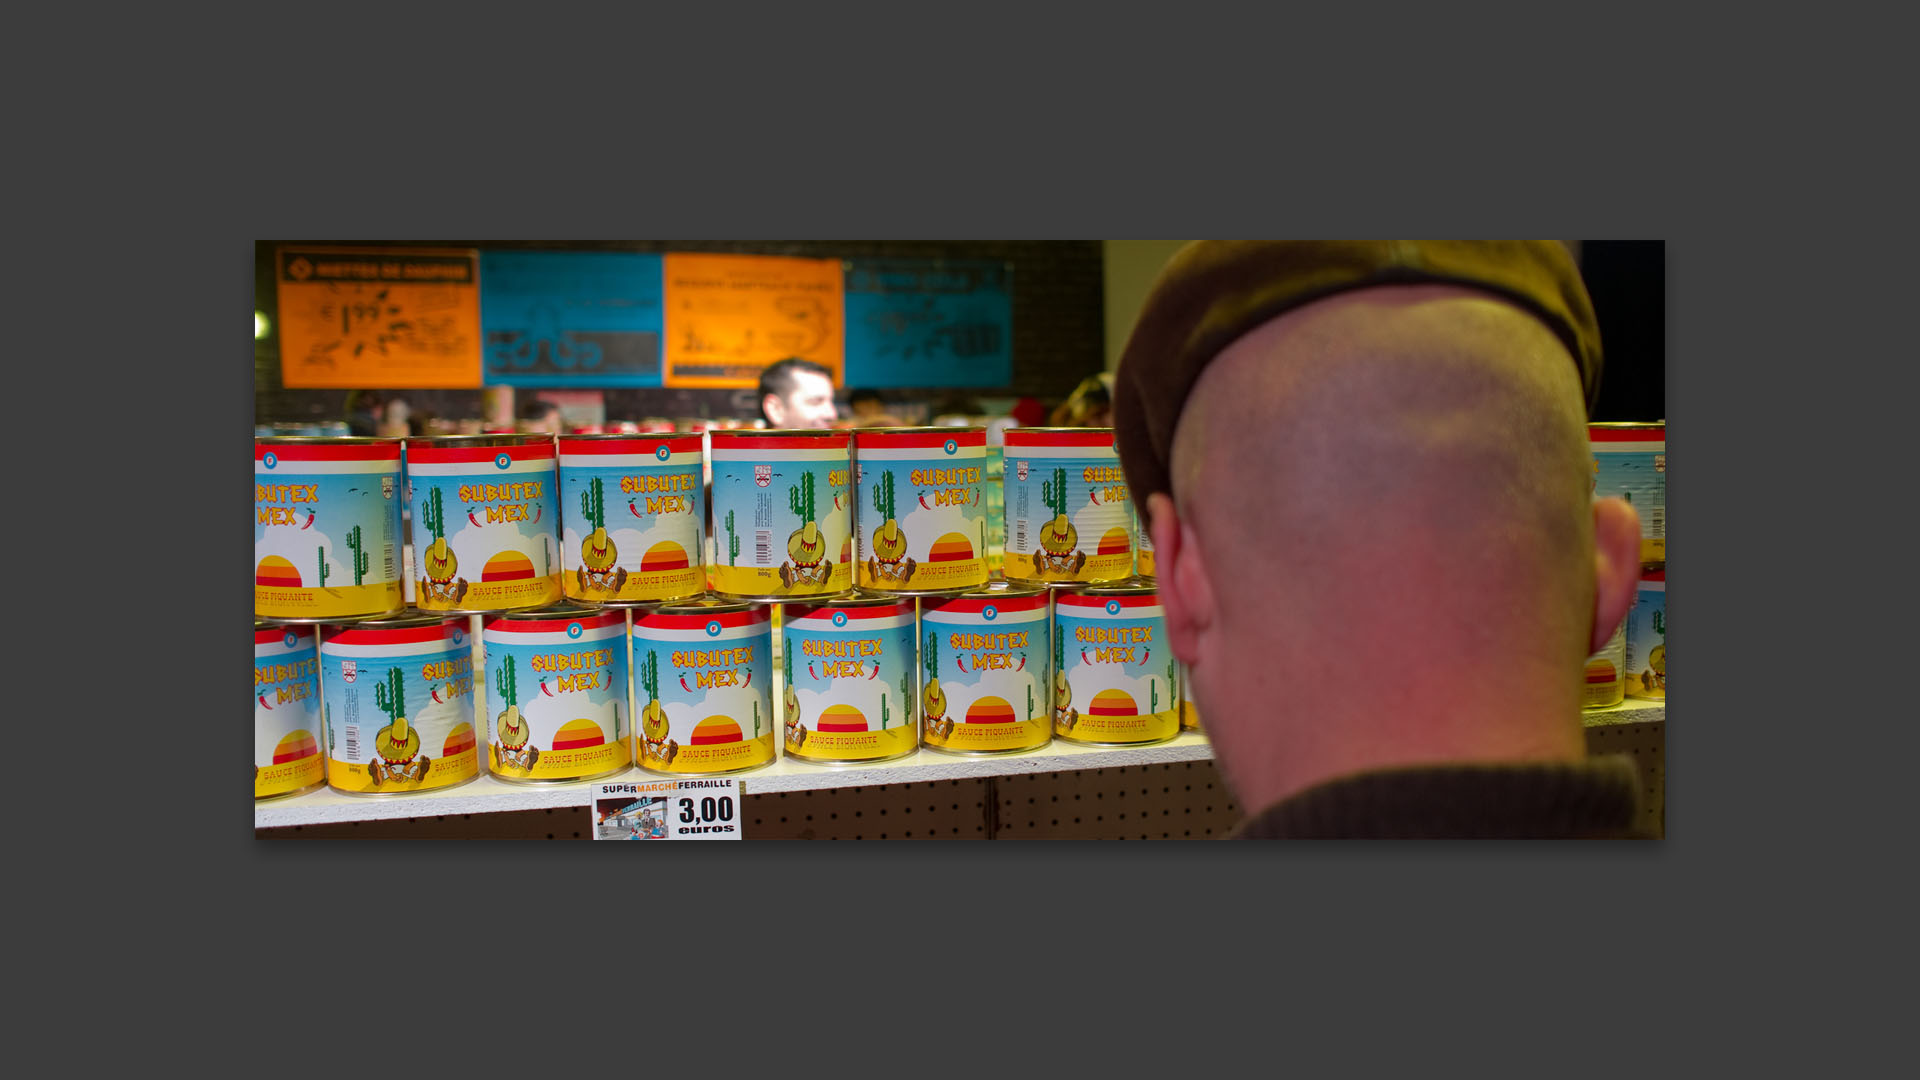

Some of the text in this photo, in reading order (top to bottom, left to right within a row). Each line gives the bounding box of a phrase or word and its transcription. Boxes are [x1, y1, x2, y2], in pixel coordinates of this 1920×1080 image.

[934, 488, 970, 507] MEX
[645, 495, 686, 515] MEX
[485, 503, 530, 525] MEX
[920, 563, 980, 576] SAUCE PIQUANTE
[1089, 559, 1110, 567] SAUCE
[632, 572, 696, 585] SAUCE PIQUANTE
[472, 582, 543, 596] SAUCE PIQUANTE
[270, 592, 313, 602] PIQUANTE
[1095, 646, 1136, 664] MEX
[822, 659, 864, 679] MEX
[971, 653, 1013, 672] MEX
[557, 671, 600, 693] MEX
[695, 668, 739, 689] MEX
[276, 683, 313, 705] MEX
[957, 726, 1023, 736] SAUCE PIQUANTE
[1082, 719, 1146, 729] SAUCE PIQUANTE
[810, 735, 878, 745] SAUCE PIQUANTE
[543, 750, 613, 764] SAUCE PIQUANTE
[682, 745, 751, 759] SAUCE PIQUANTE
[263, 767, 293, 780] SAUCE
[435, 761, 459, 772] SAUCE
[678, 796, 733, 825] 3,00
[678, 824, 735, 834] euros
